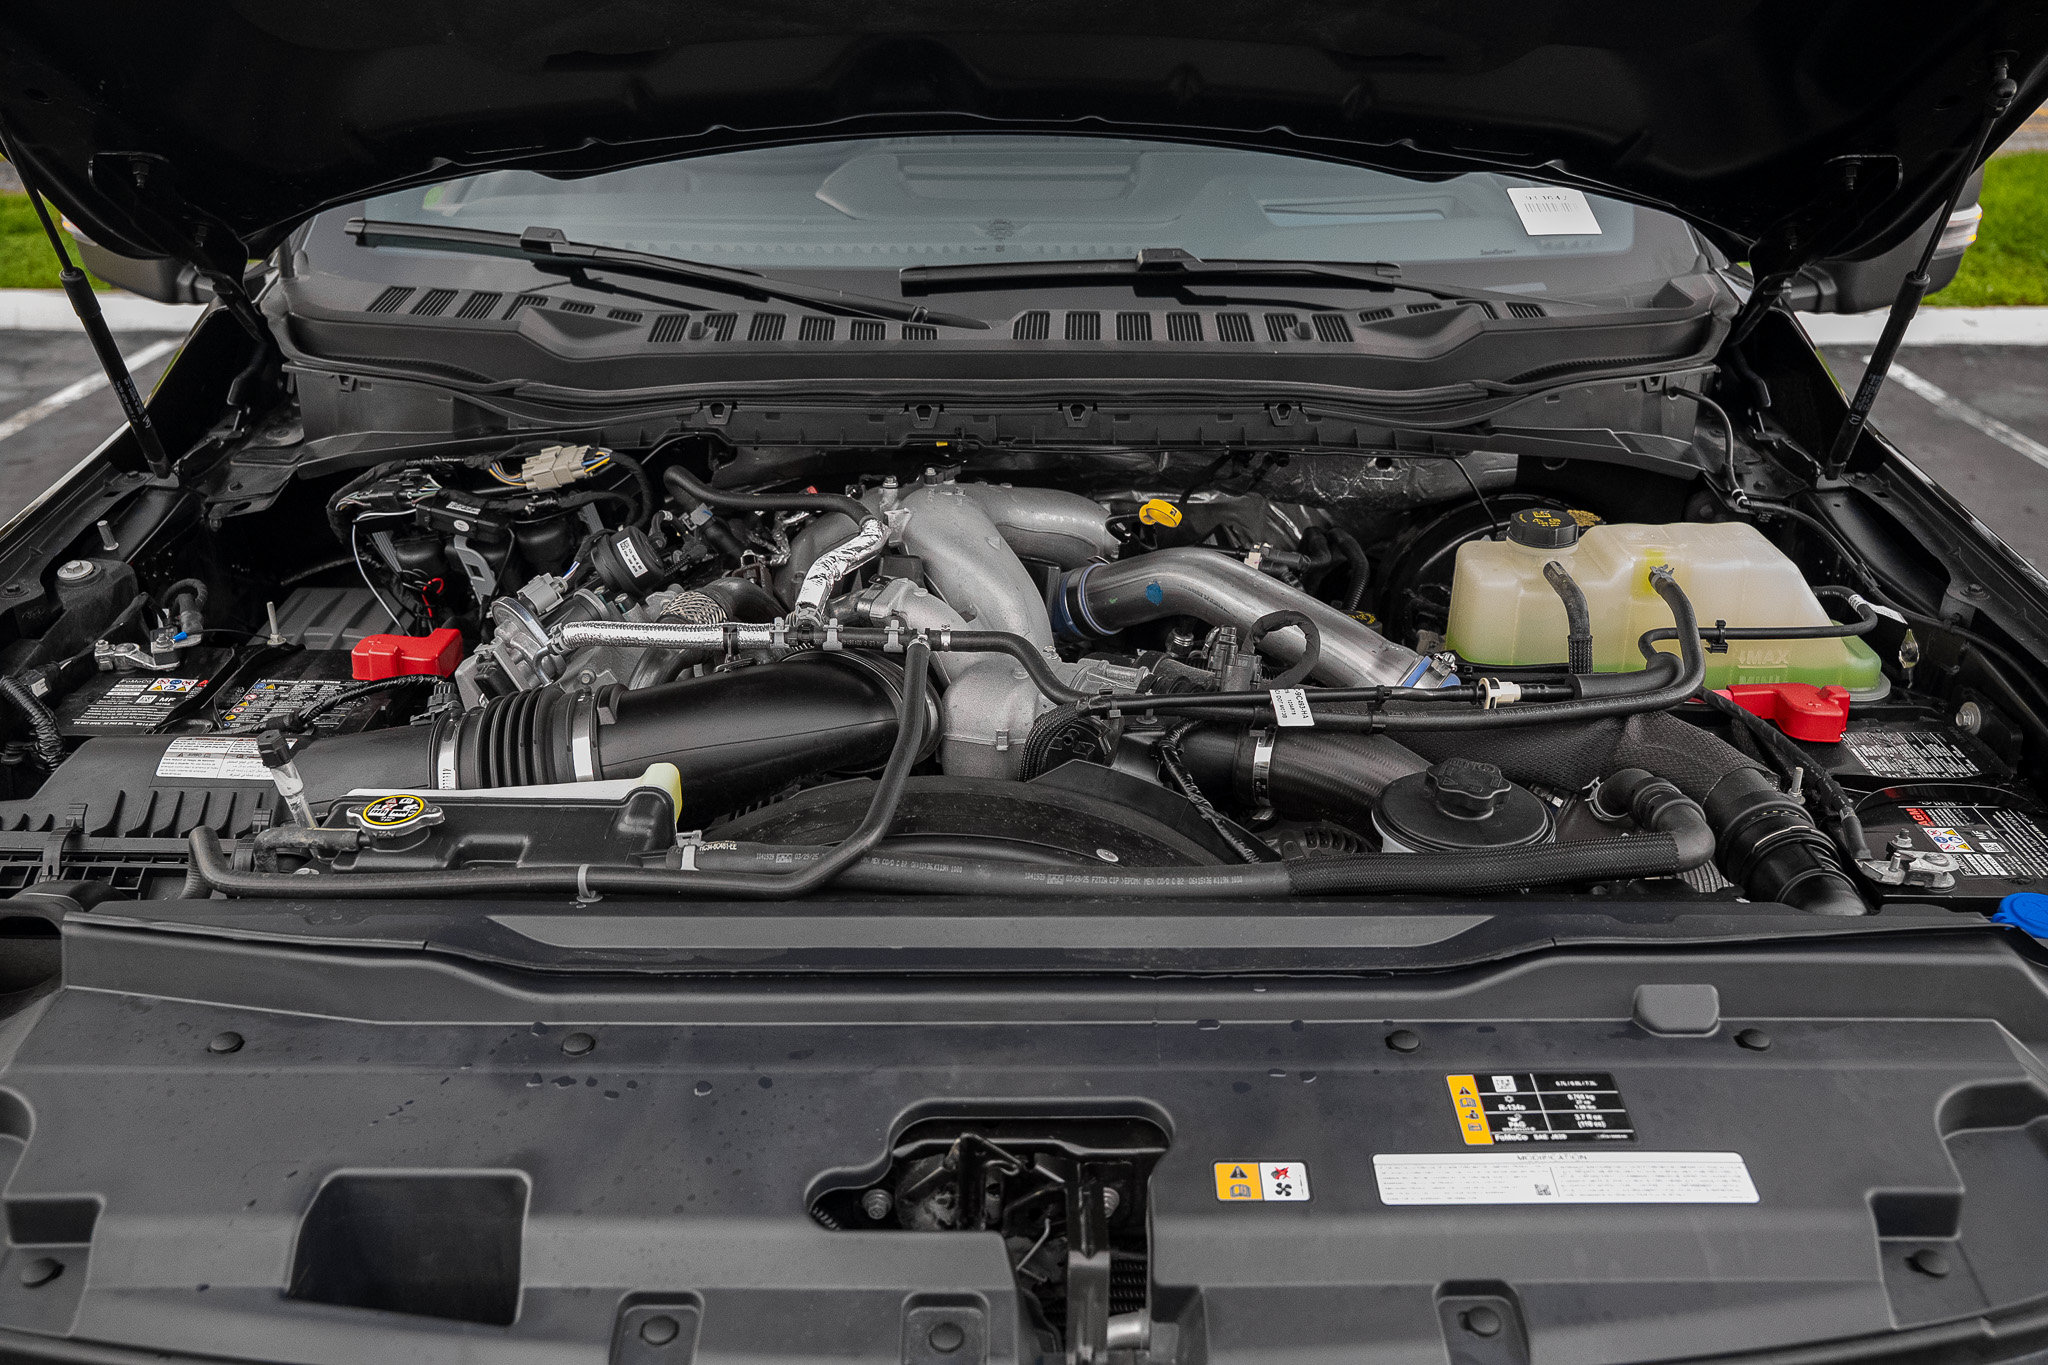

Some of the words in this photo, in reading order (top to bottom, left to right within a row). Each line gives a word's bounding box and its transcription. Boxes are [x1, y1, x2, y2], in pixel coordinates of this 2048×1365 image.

[1747, 650, 1788, 664] MAX
[1905, 808, 1930, 827] AGM
[1494, 1133, 1529, 1141] FoMoCo
